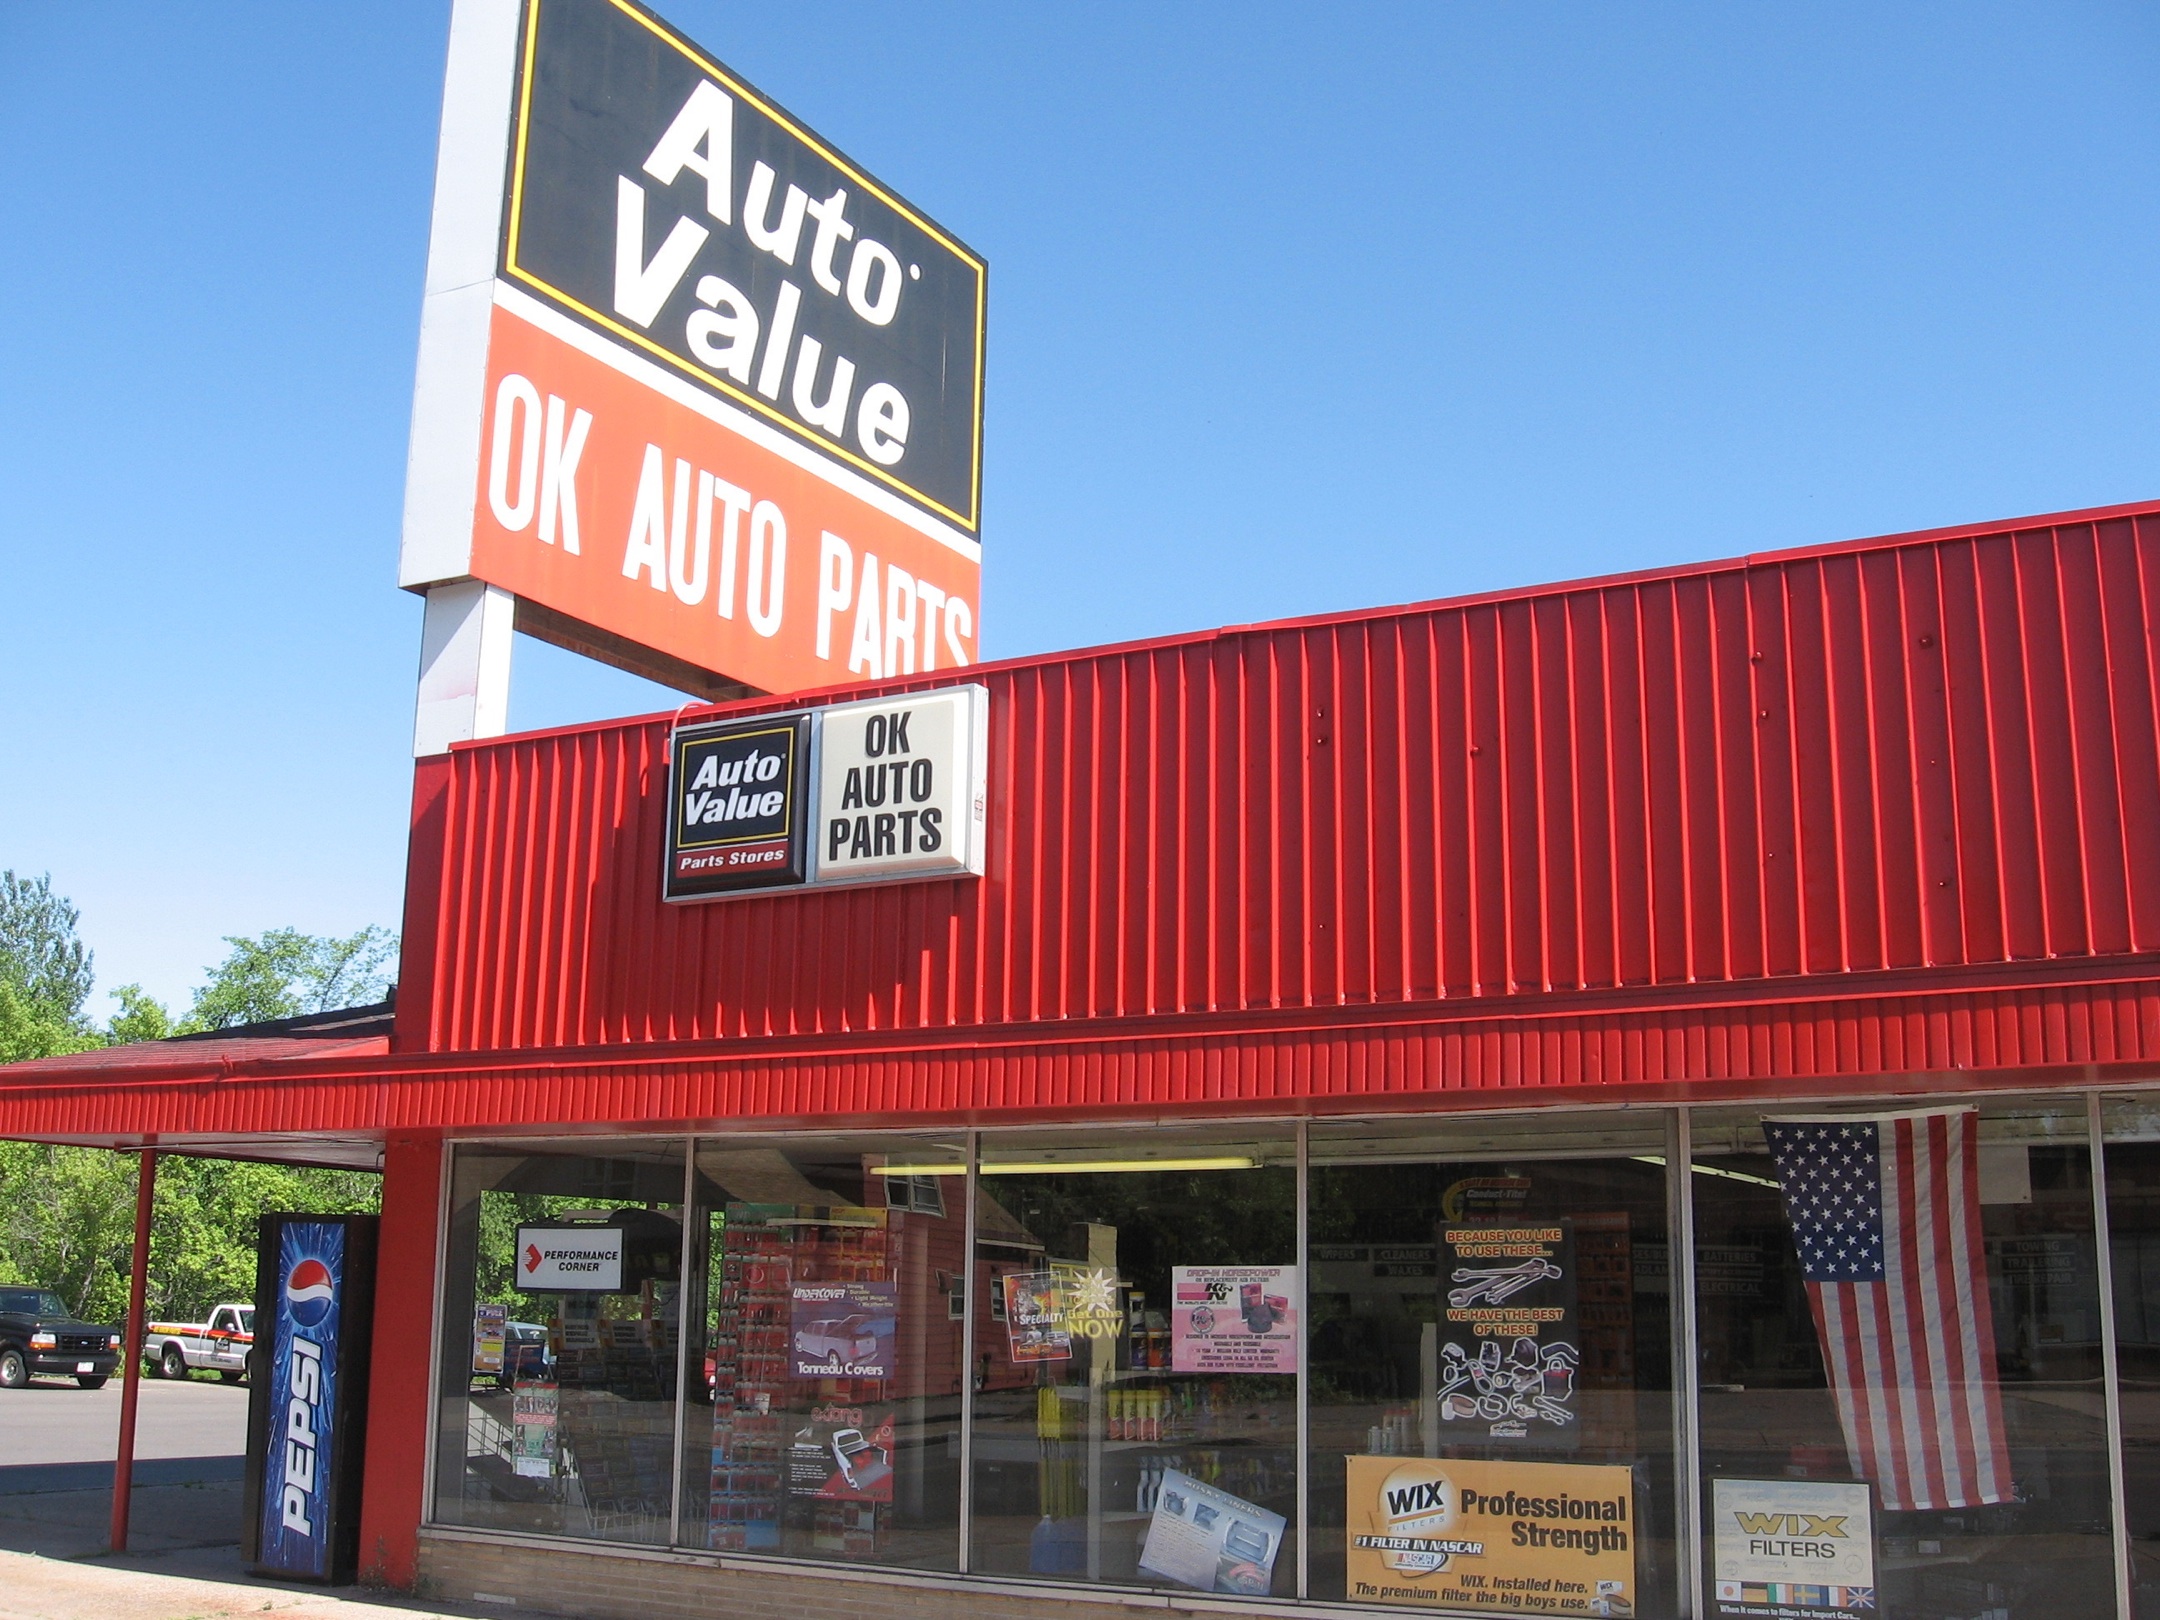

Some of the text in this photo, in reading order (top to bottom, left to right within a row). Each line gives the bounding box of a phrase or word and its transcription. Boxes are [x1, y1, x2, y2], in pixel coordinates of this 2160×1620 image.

[643, 79, 903, 326] Auto
[614, 174, 911, 466] Value
[488, 373, 972, 680] OK AUTO PARTS
[865, 711, 912, 758] OK
[690, 749, 782, 791] Auto
[841, 758, 933, 810] AUTO
[685, 789, 784, 826] Value
[829, 807, 943, 862] PARTS
[680, 850, 785, 871] Parts Stores
[1446, 1229, 1562, 1242] BECAUSE YOU LIKE
[1320, 1249, 1356, 1260] WIPERS
[1381, 1249, 1431, 1260] CLEANERS
[1456, 1244, 1553, 1257] TO USE THESE...
[2016, 1240, 2060, 1251] TOWING
[544, 1250, 619, 1261] PERFORMANCE
[1703, 1251, 1756, 1262] BATTERIES
[559, 1262, 600, 1272] CORNER
[1222, 1269, 1281, 1277] HORSEPOWER
[1388, 1264, 1423, 1276] WAXES
[1699, 1282, 1760, 1293] ELECTRICAL
[1447, 1308, 1564, 1321] WE HAVE THE BEST
[1068, 1320, 1124, 1339] NOW
[1474, 1323, 1539, 1336] OF THESE!
[797, 1361, 884, 1376] Tonneau Covers
[282, 1336, 321, 1537] PEPSI
[1185, 1480, 1221, 1498] HUSKY
[1387, 1480, 1444, 1516] WIX
[1461, 1489, 1627, 1522] Professional
[1387, 1515, 1446, 1533] FILTERS
[1733, 1511, 1850, 1539] WIX
[1355, 1535, 1483, 1555] #1 FILTER IN NASCAR
[1511, 1521, 1627, 1555] Strength
[1750, 1539, 1836, 1559] FILTERS
[1460, 1574, 1588, 1594] WIX. Installed here.
[1355, 1582, 1378, 1595] The
[1380, 1586, 1437, 1601] premium
[1440, 1588, 1472, 1603] filter
[1475, 1589, 1497, 1604] the
[1500, 1591, 1522, 1607] big
[1525, 1593, 1557, 1609] boys
[1560, 1596, 1589, 1610] use.
[1720, 1604, 1740, 1614] When
[1770, 1607, 1778, 1615] to
[1779, 1607, 1800, 1617] filters
[1801, 1608, 1811, 1618] for
